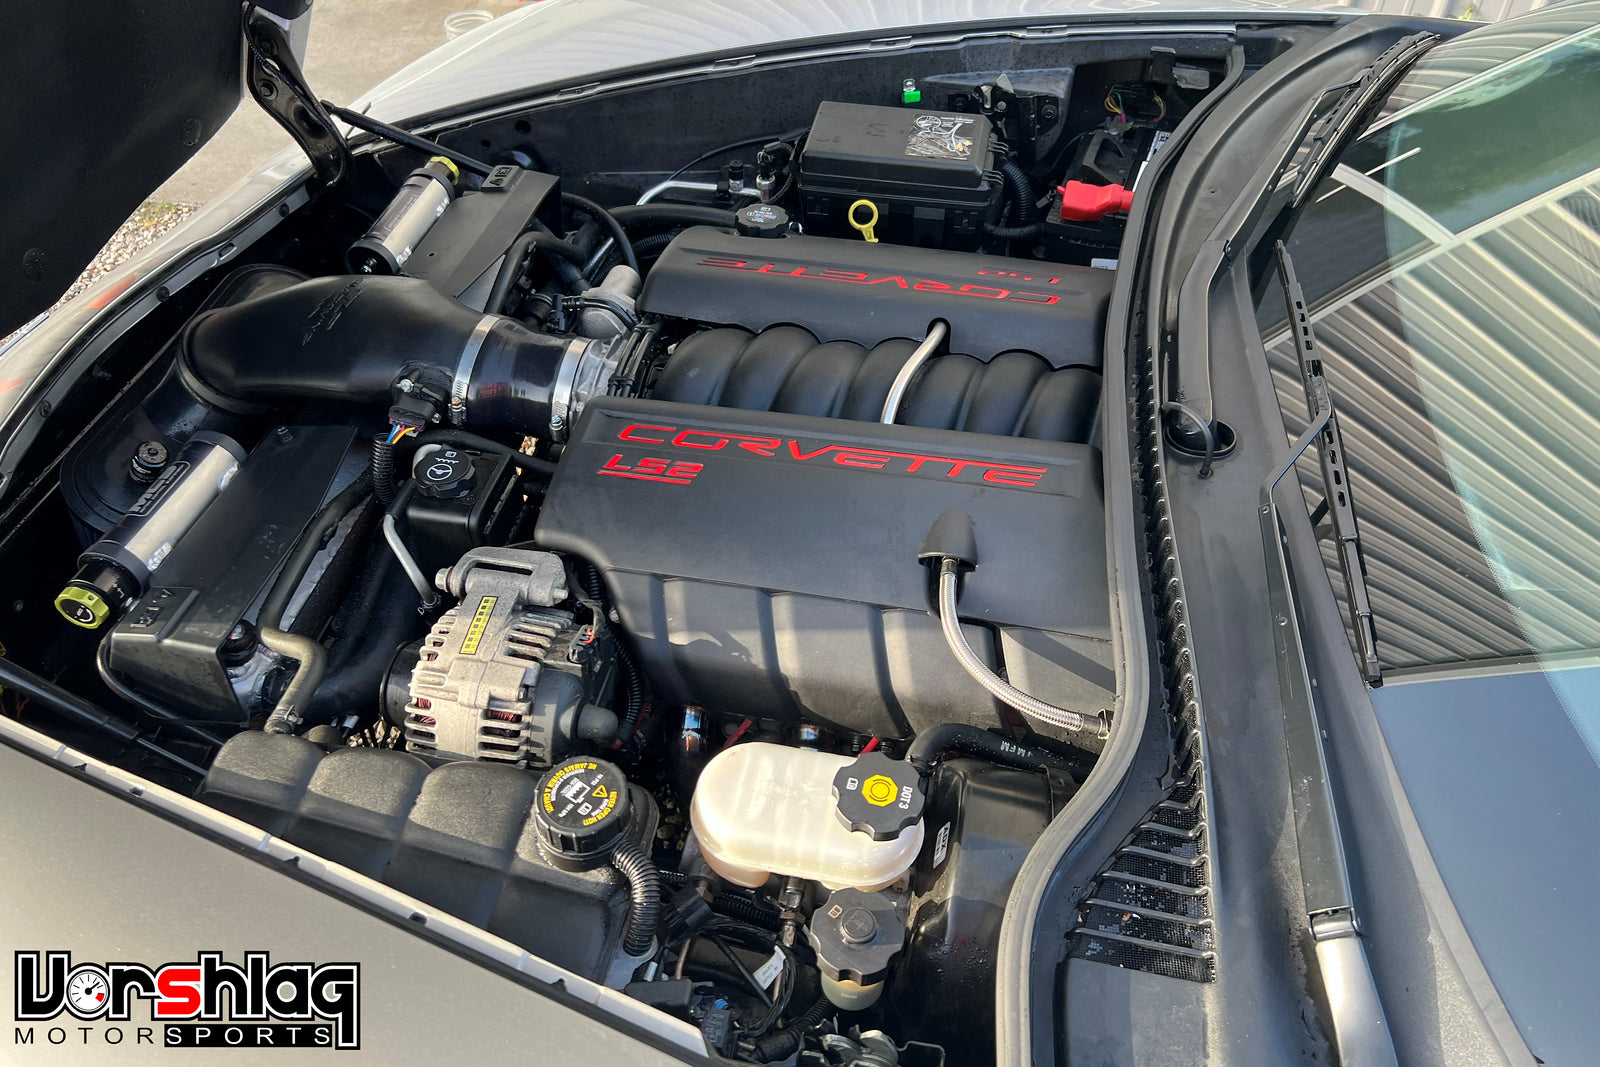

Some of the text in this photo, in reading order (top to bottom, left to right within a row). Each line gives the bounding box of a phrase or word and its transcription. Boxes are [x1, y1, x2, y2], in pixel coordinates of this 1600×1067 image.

[696, 257, 1061, 305] CORVETTE
[602, 453, 704, 479] LS2
[617, 424, 1048, 487] CORVETTE
